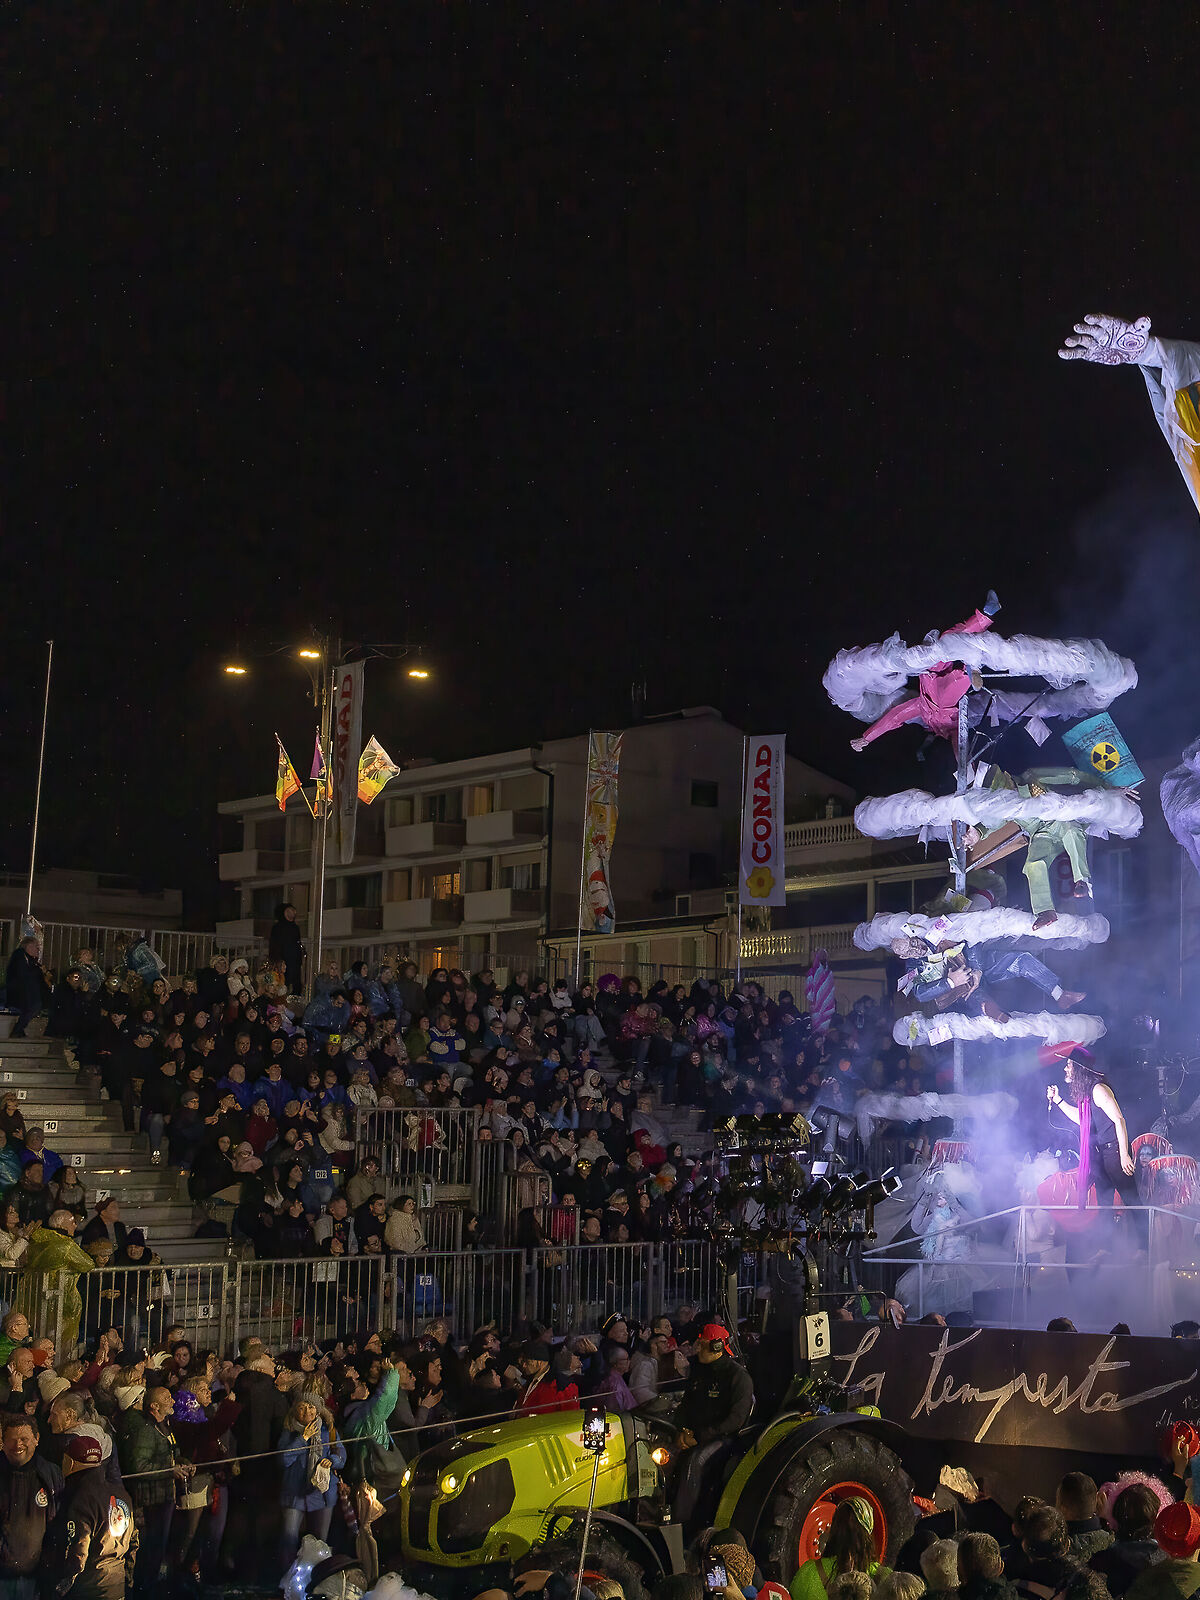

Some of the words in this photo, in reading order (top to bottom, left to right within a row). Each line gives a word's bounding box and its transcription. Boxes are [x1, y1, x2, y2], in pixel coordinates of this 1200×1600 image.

[752, 744, 772, 863] CONAD
[46, 1121, 56, 1130] 10
[75, 1156, 82, 1165] 3
[202, 1306, 209, 1316] 9
[815, 1332, 824, 1347] 6
[833, 1326, 886, 1405] La
